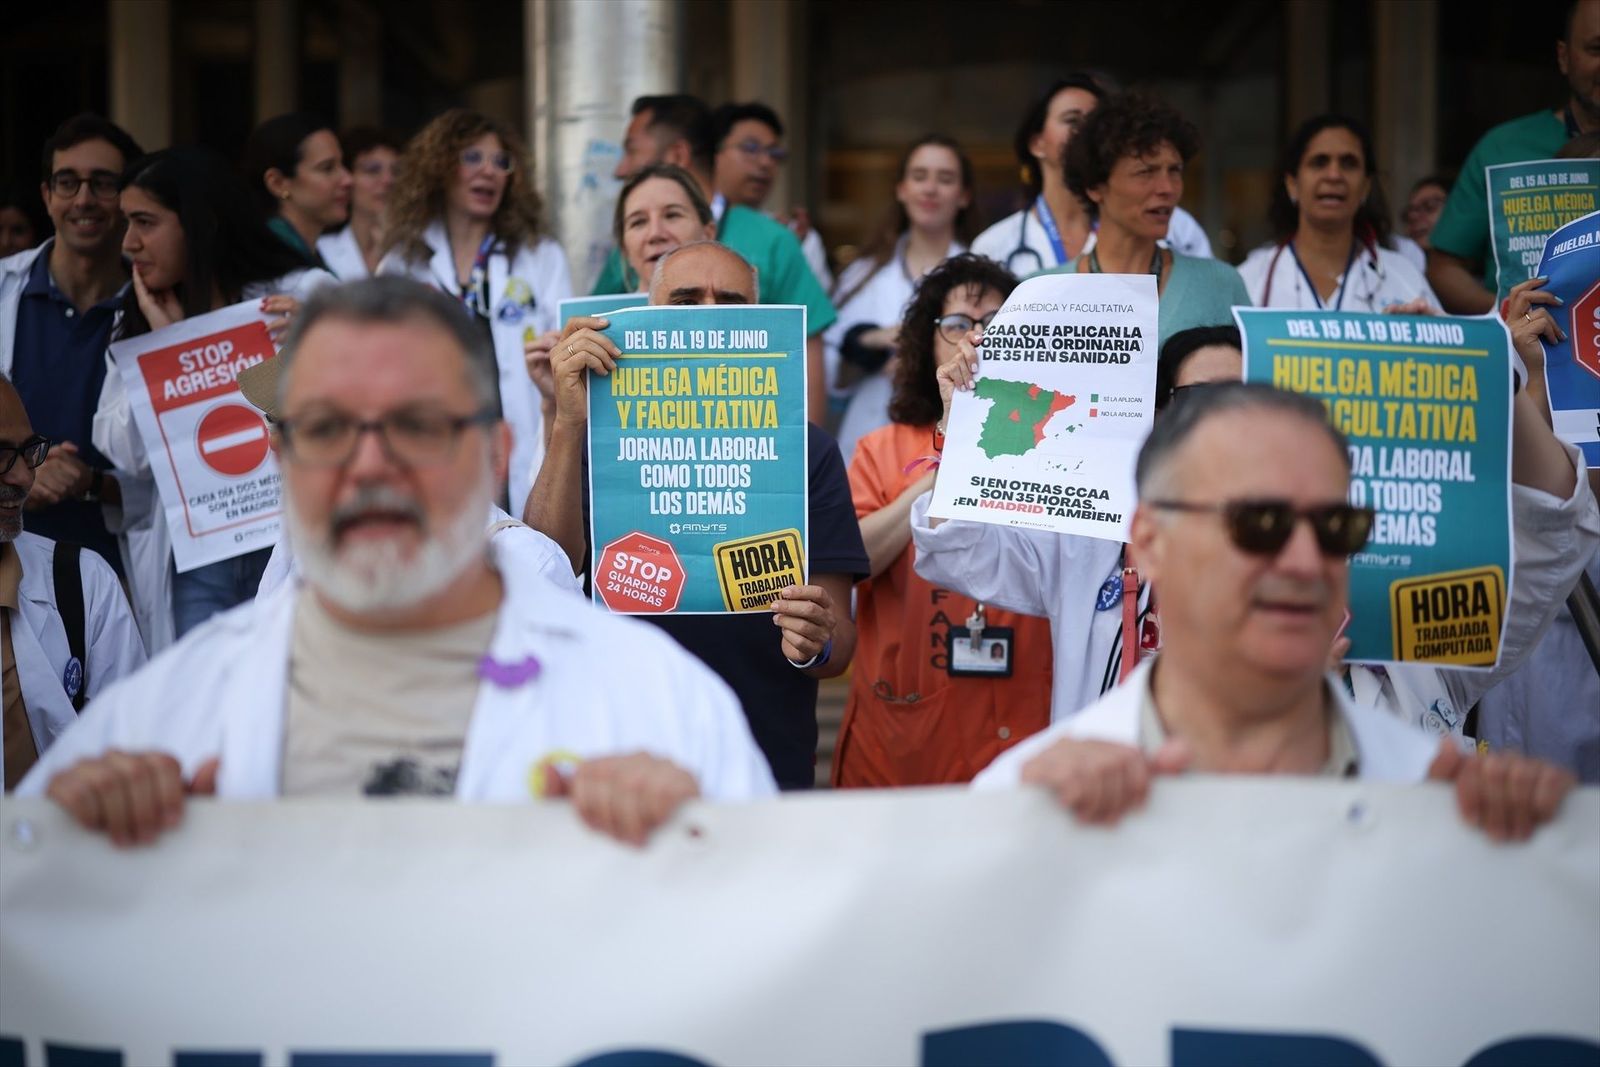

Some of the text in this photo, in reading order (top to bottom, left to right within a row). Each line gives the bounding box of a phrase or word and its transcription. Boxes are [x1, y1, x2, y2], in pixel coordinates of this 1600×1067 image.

[1510, 173, 1589, 188] DEL 15 AL 19 DE JUNIO
[1504, 192, 1595, 216] HUELGA MÉDICA
[1508, 217, 1515, 234] Y
[1508, 234, 1549, 252] JORNAD
[1553, 233, 1593, 256] HUELGA
[1062, 304, 1068, 312] Y
[1070, 304, 1134, 312] FACULTATIVA
[625, 330, 768, 349] DEL 15 AL 19 DE JUNIO
[1019, 325, 1050, 339] QUE
[1052, 326, 1121, 338] APLICAN
[1124, 327, 1142, 338] LA
[1287, 319, 1464, 345] DEL 15 AL 19 DE JUNIO
[178, 340, 234, 372] STOP
[981, 337, 1144, 354] ORNADA (ORDINARIA)
[983, 350, 1130, 364] DE 35 H EN SANIDAD
[611, 364, 779, 396] HUELGA MÉDICA
[1273, 355, 1478, 401] HUELGA MÉDICA
[616, 400, 779, 430] Y FACULTATIVA
[1323, 398, 1477, 442] CULTATIVA
[617, 437, 778, 462] JORNADA LABORAL
[640, 464, 751, 488] COMO TODOS
[1379, 448, 1475, 482] LABORAL
[189, 472, 284, 508] CADA DÍA DOS MÉDI
[971, 476, 1110, 500] SI EN OTRAS CCAA
[980, 488, 1096, 510] SON 35 HORAS.
[1370, 482, 1442, 513] TODOS
[208, 502, 228, 514] SON
[226, 499, 278, 520] EN MADRID
[650, 489, 746, 515] LOS DEMÁS
[953, 497, 978, 506] ¡EN
[980, 500, 1044, 514] MADRID
[1368, 512, 1436, 546] EMÁS
[613, 552, 672, 583] STOP
[729, 541, 794, 580] HORA
[606, 581, 662, 607] 24 HORAS
[609, 570, 667, 598] GUARDIAS
[738, 574, 796, 596] TRABAJADA
[740, 592, 786, 609] COMPUT
[1411, 580, 1491, 624] HORA
[1416, 620, 1490, 643] TRABAJADA
[1414, 638, 1492, 660] COMPUTADA
